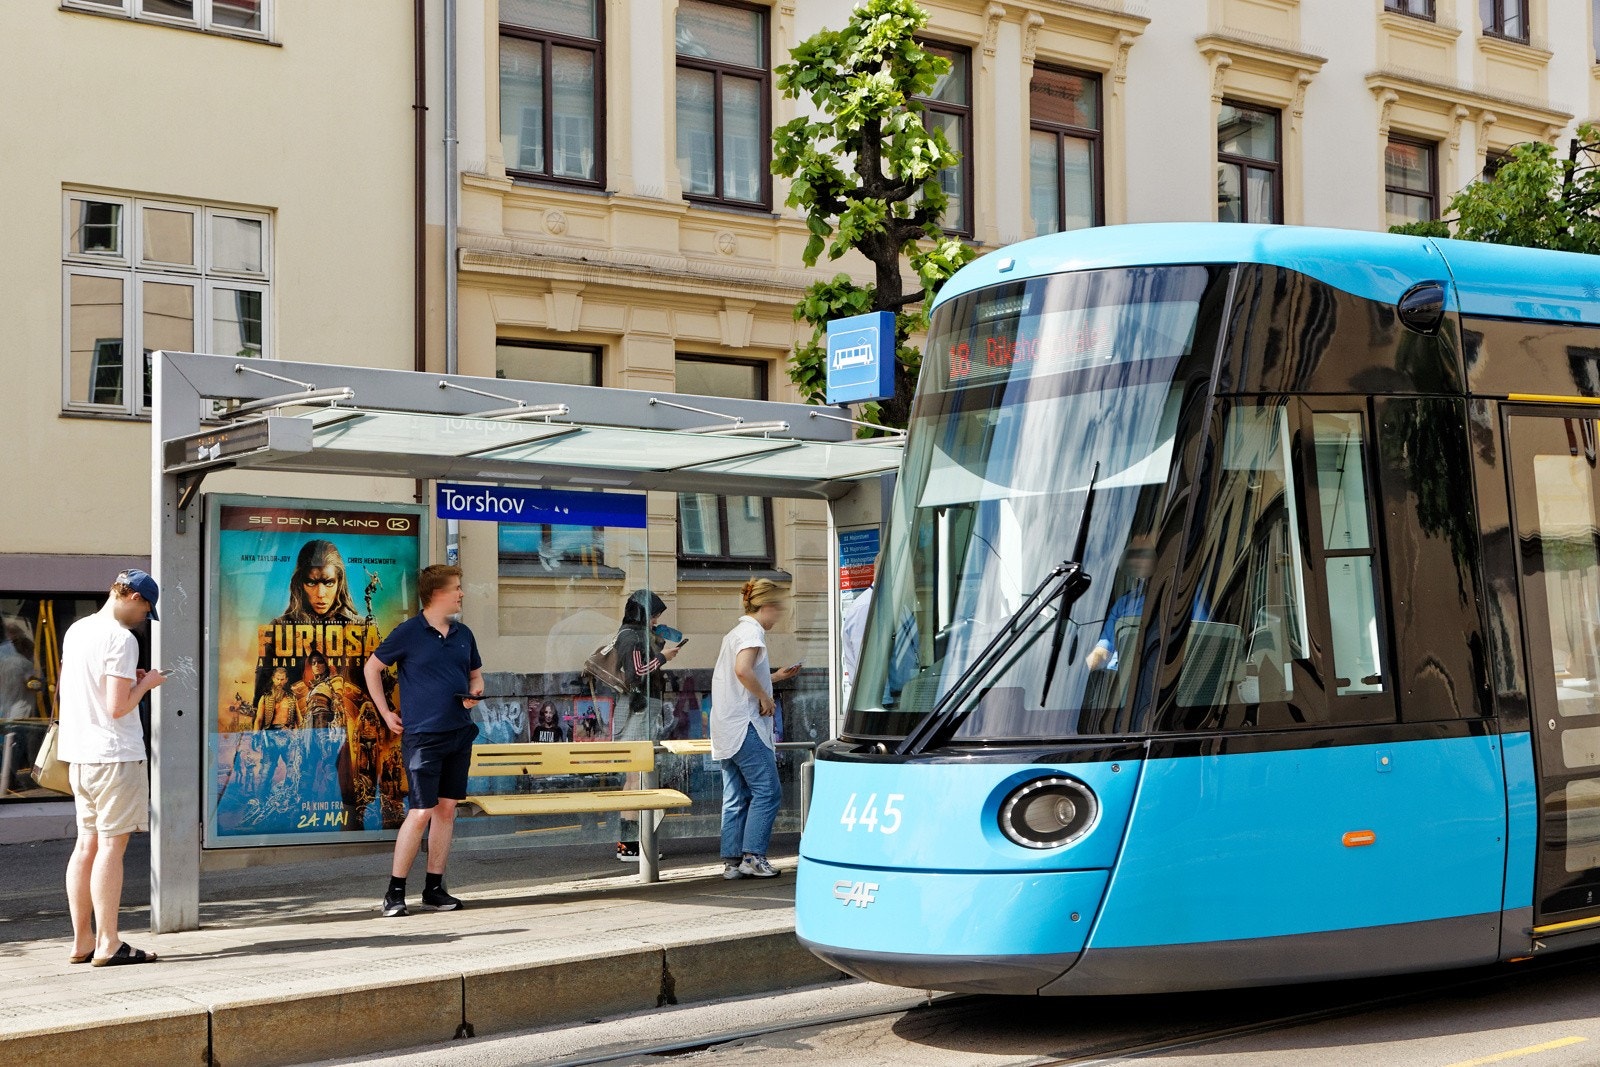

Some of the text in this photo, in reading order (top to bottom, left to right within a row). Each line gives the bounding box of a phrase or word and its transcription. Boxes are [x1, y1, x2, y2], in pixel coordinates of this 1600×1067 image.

[949, 320, 1107, 379] 18 Rikshotalet
[441, 489, 525, 514] Torshov
[249, 516, 380, 528] SE DEN PÅ KINO
[241, 554, 291, 563] ANYA TAYLOR-JOY
[364, 557, 396, 565] HEMSWORTH
[258, 624, 381, 657] FURIOSA
[258, 657, 264, 667] A
[272, 657, 296, 667] MAD
[328, 657, 350, 667] MAX
[301, 800, 344, 811] PÅ KINO FRA
[840, 793, 905, 834] 445
[297, 811, 349, 828] 24. MAI
[832, 880, 880, 908] CAF
